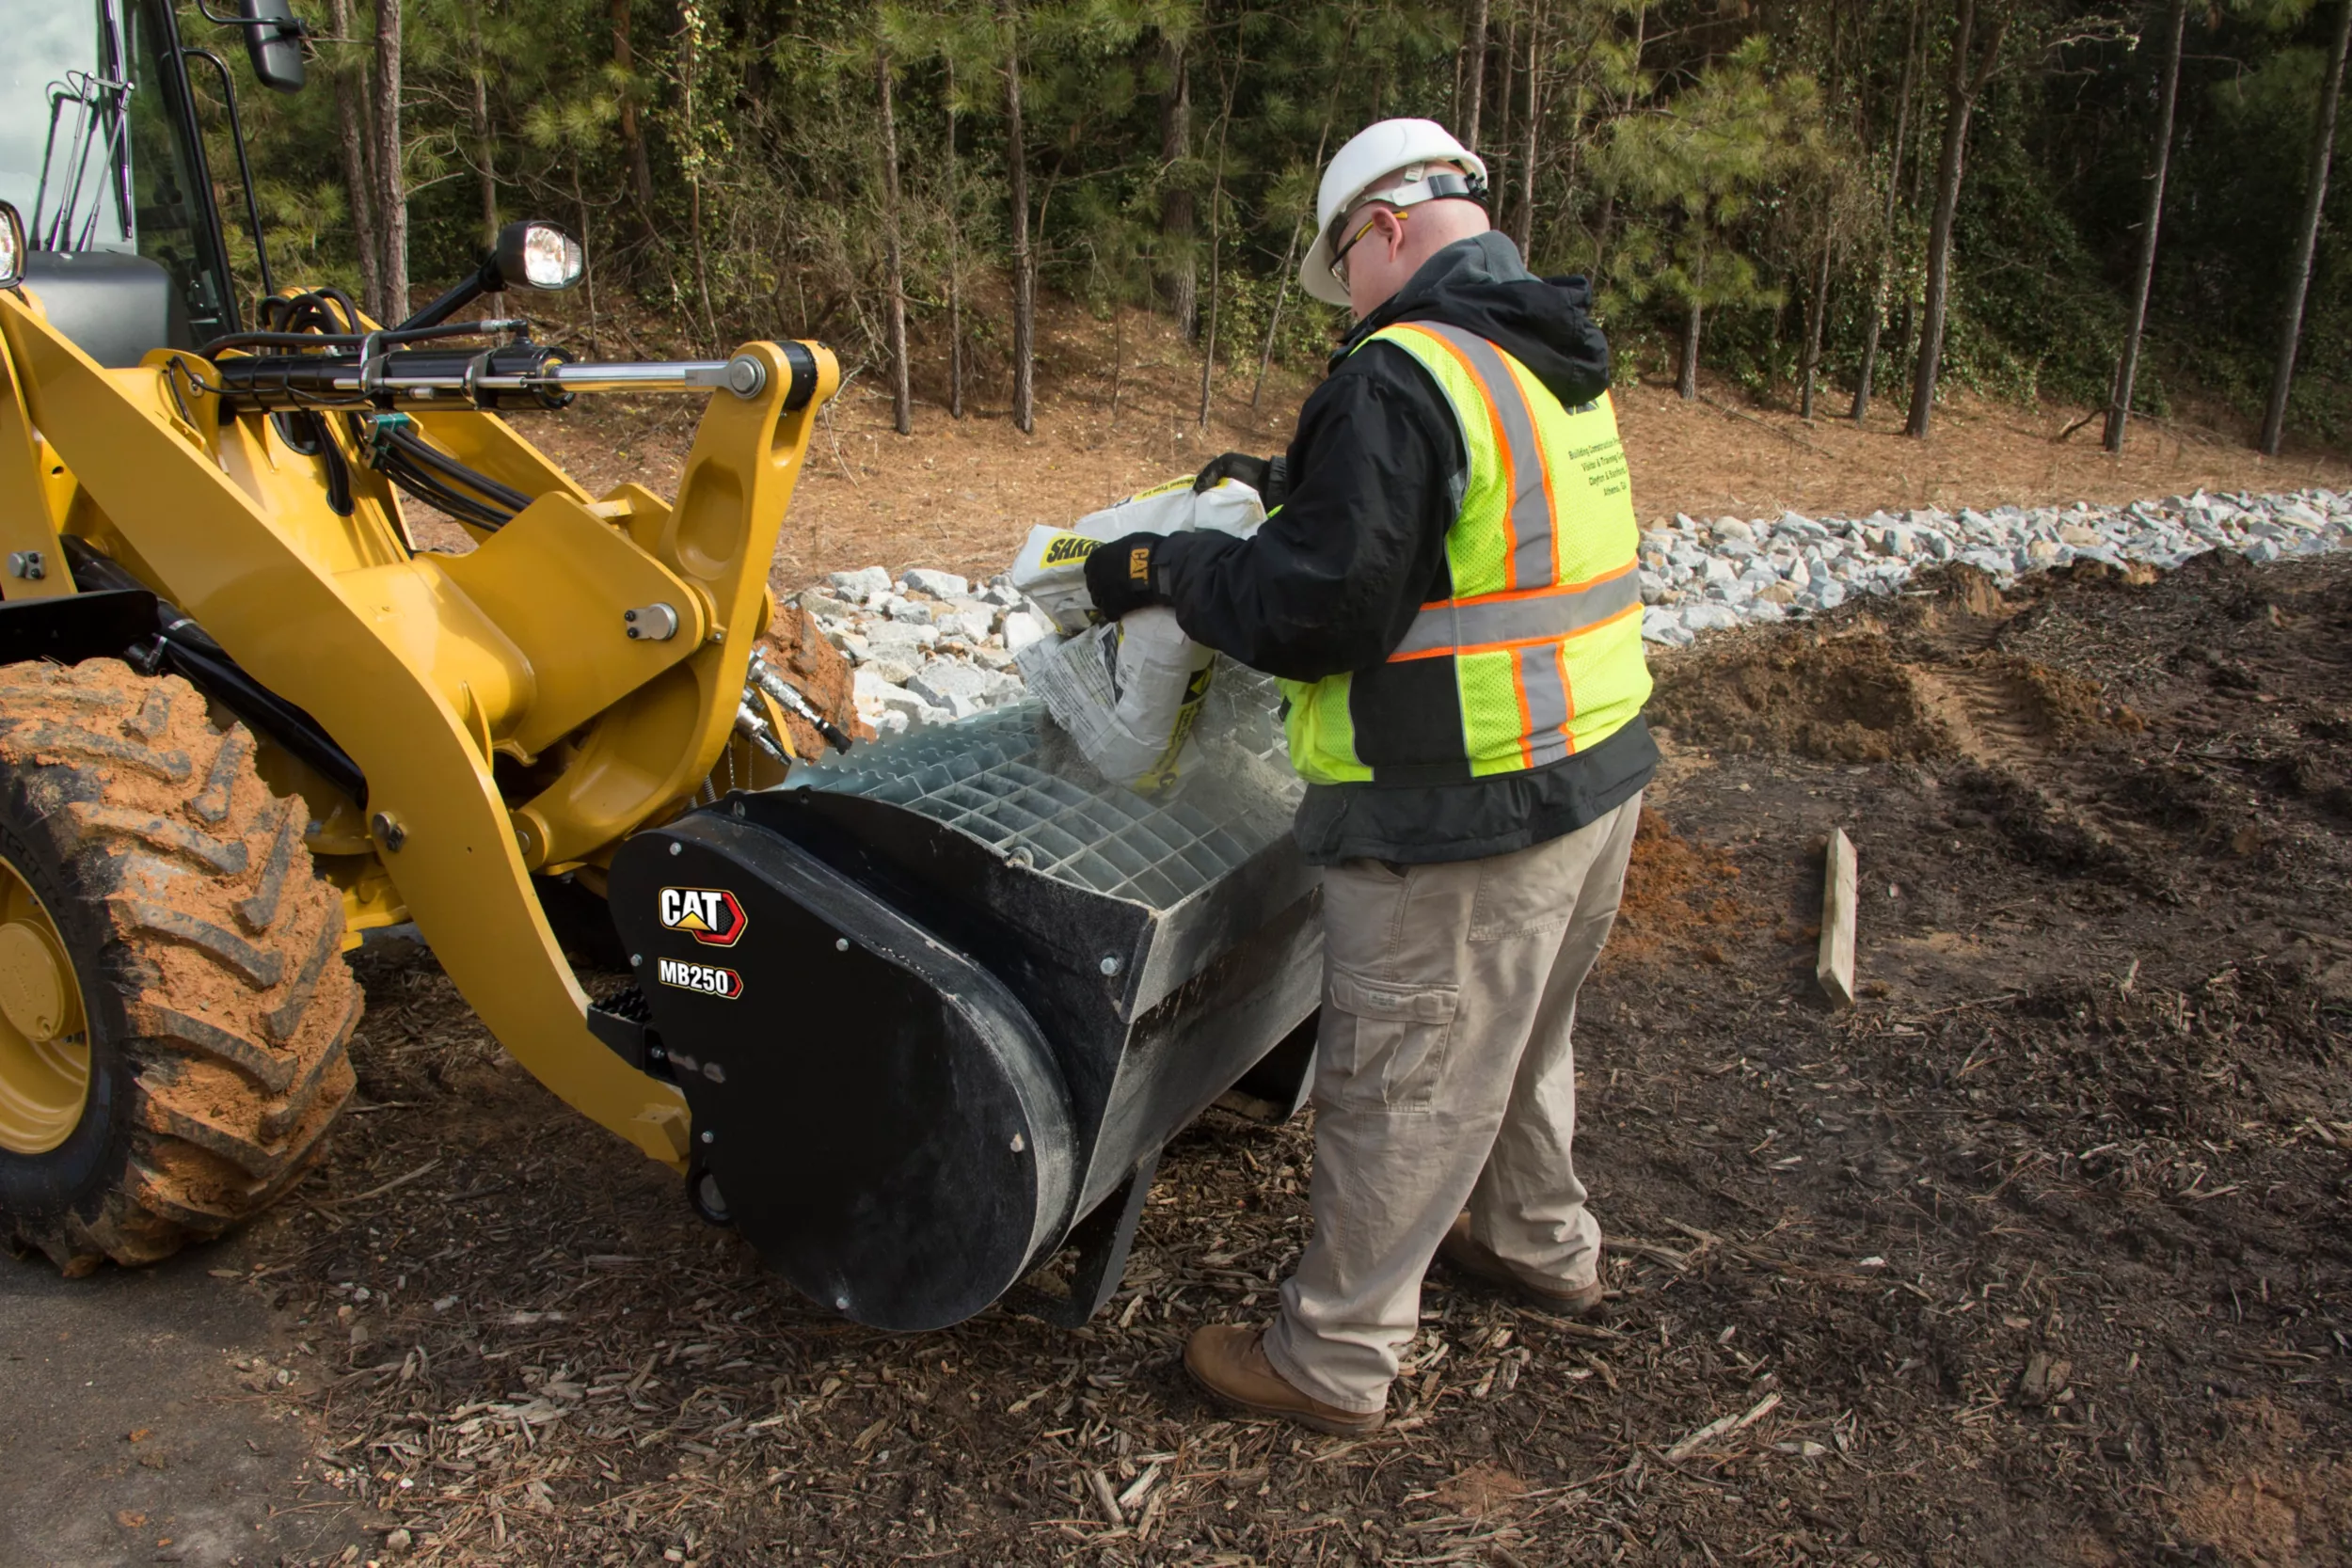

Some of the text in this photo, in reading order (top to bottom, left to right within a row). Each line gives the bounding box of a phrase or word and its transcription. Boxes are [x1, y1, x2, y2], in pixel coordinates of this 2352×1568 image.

[1131, 547, 1149, 580] CAT
[660, 889, 723, 932] CAT
[660, 959, 729, 995] MB250
